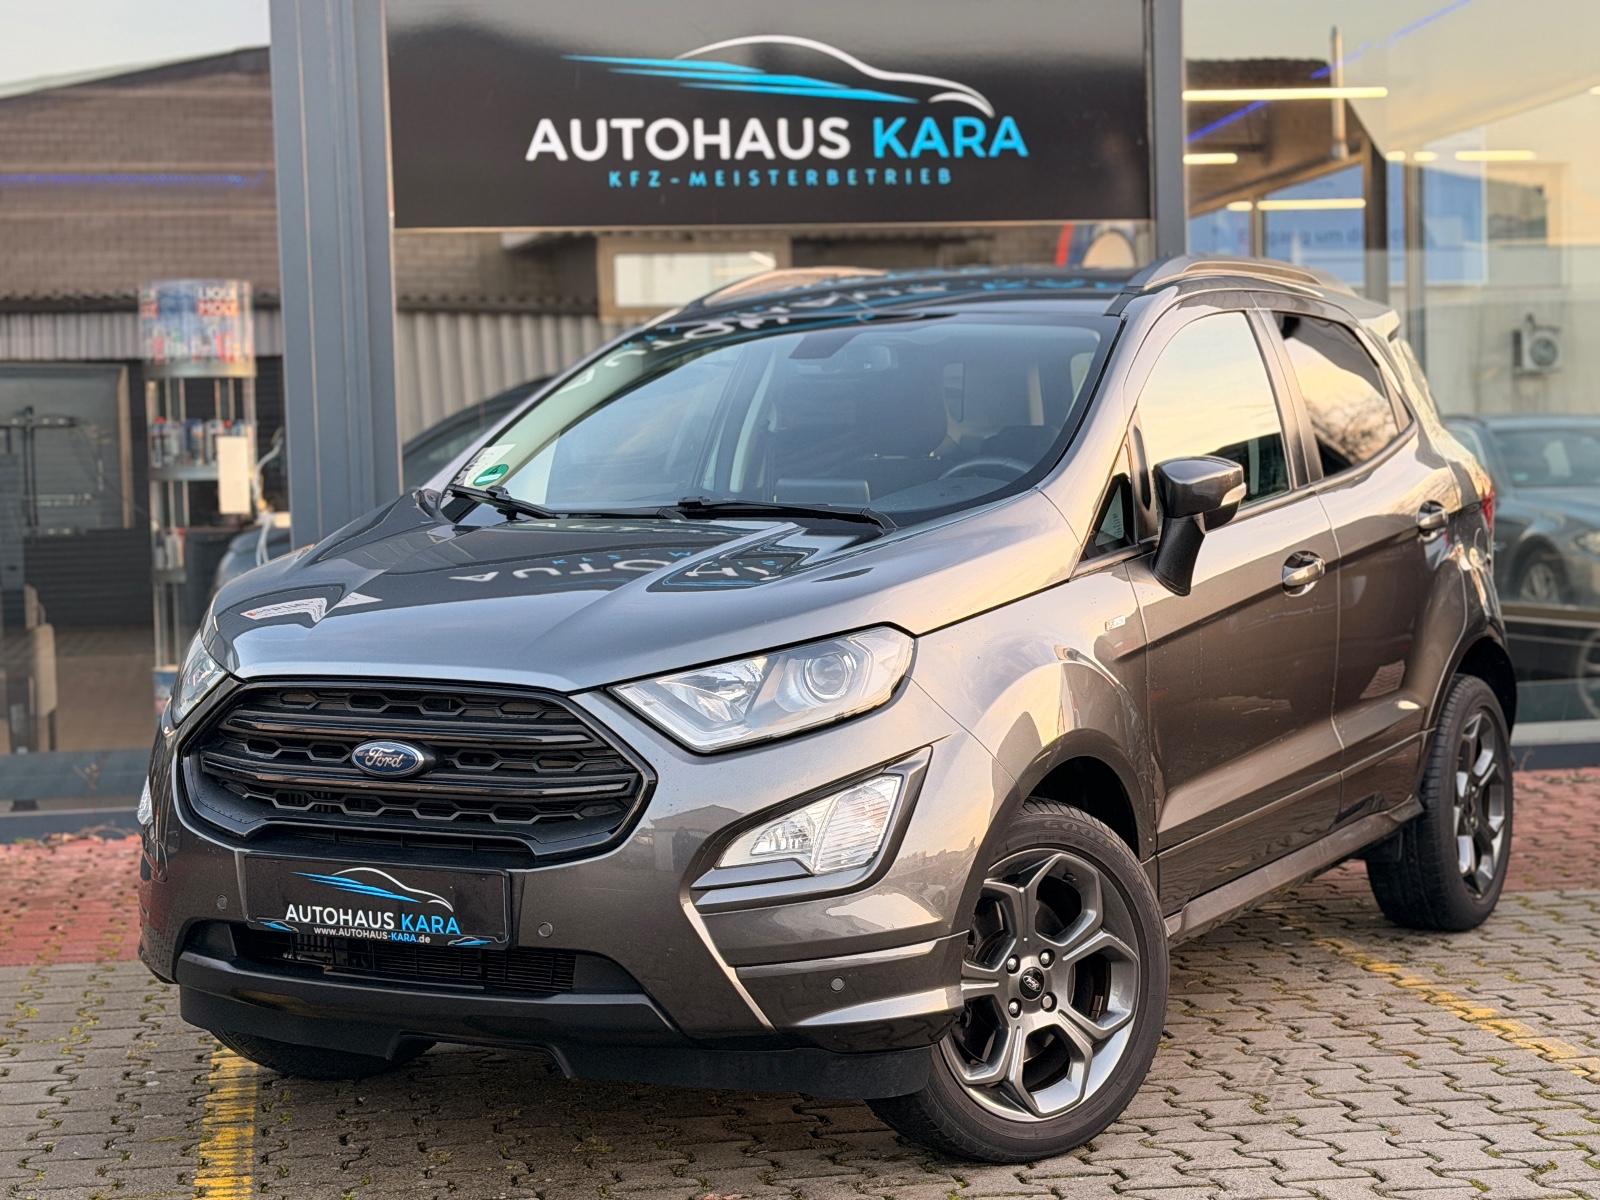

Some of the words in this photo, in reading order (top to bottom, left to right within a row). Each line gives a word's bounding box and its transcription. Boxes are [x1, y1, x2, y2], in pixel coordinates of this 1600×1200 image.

[525, 117, 851, 162] AUTOHAUS
[872, 115, 1029, 160] KARA
[608, 167, 953, 188] KFZ-MEISTERBETRIEB
[364, 746, 404, 768] Ford
[285, 903, 395, 930] AUTOHAUS
[401, 913, 461, 935] KARA
[313, 926, 431, 944] www.AUTOHAUS-KARA.de
